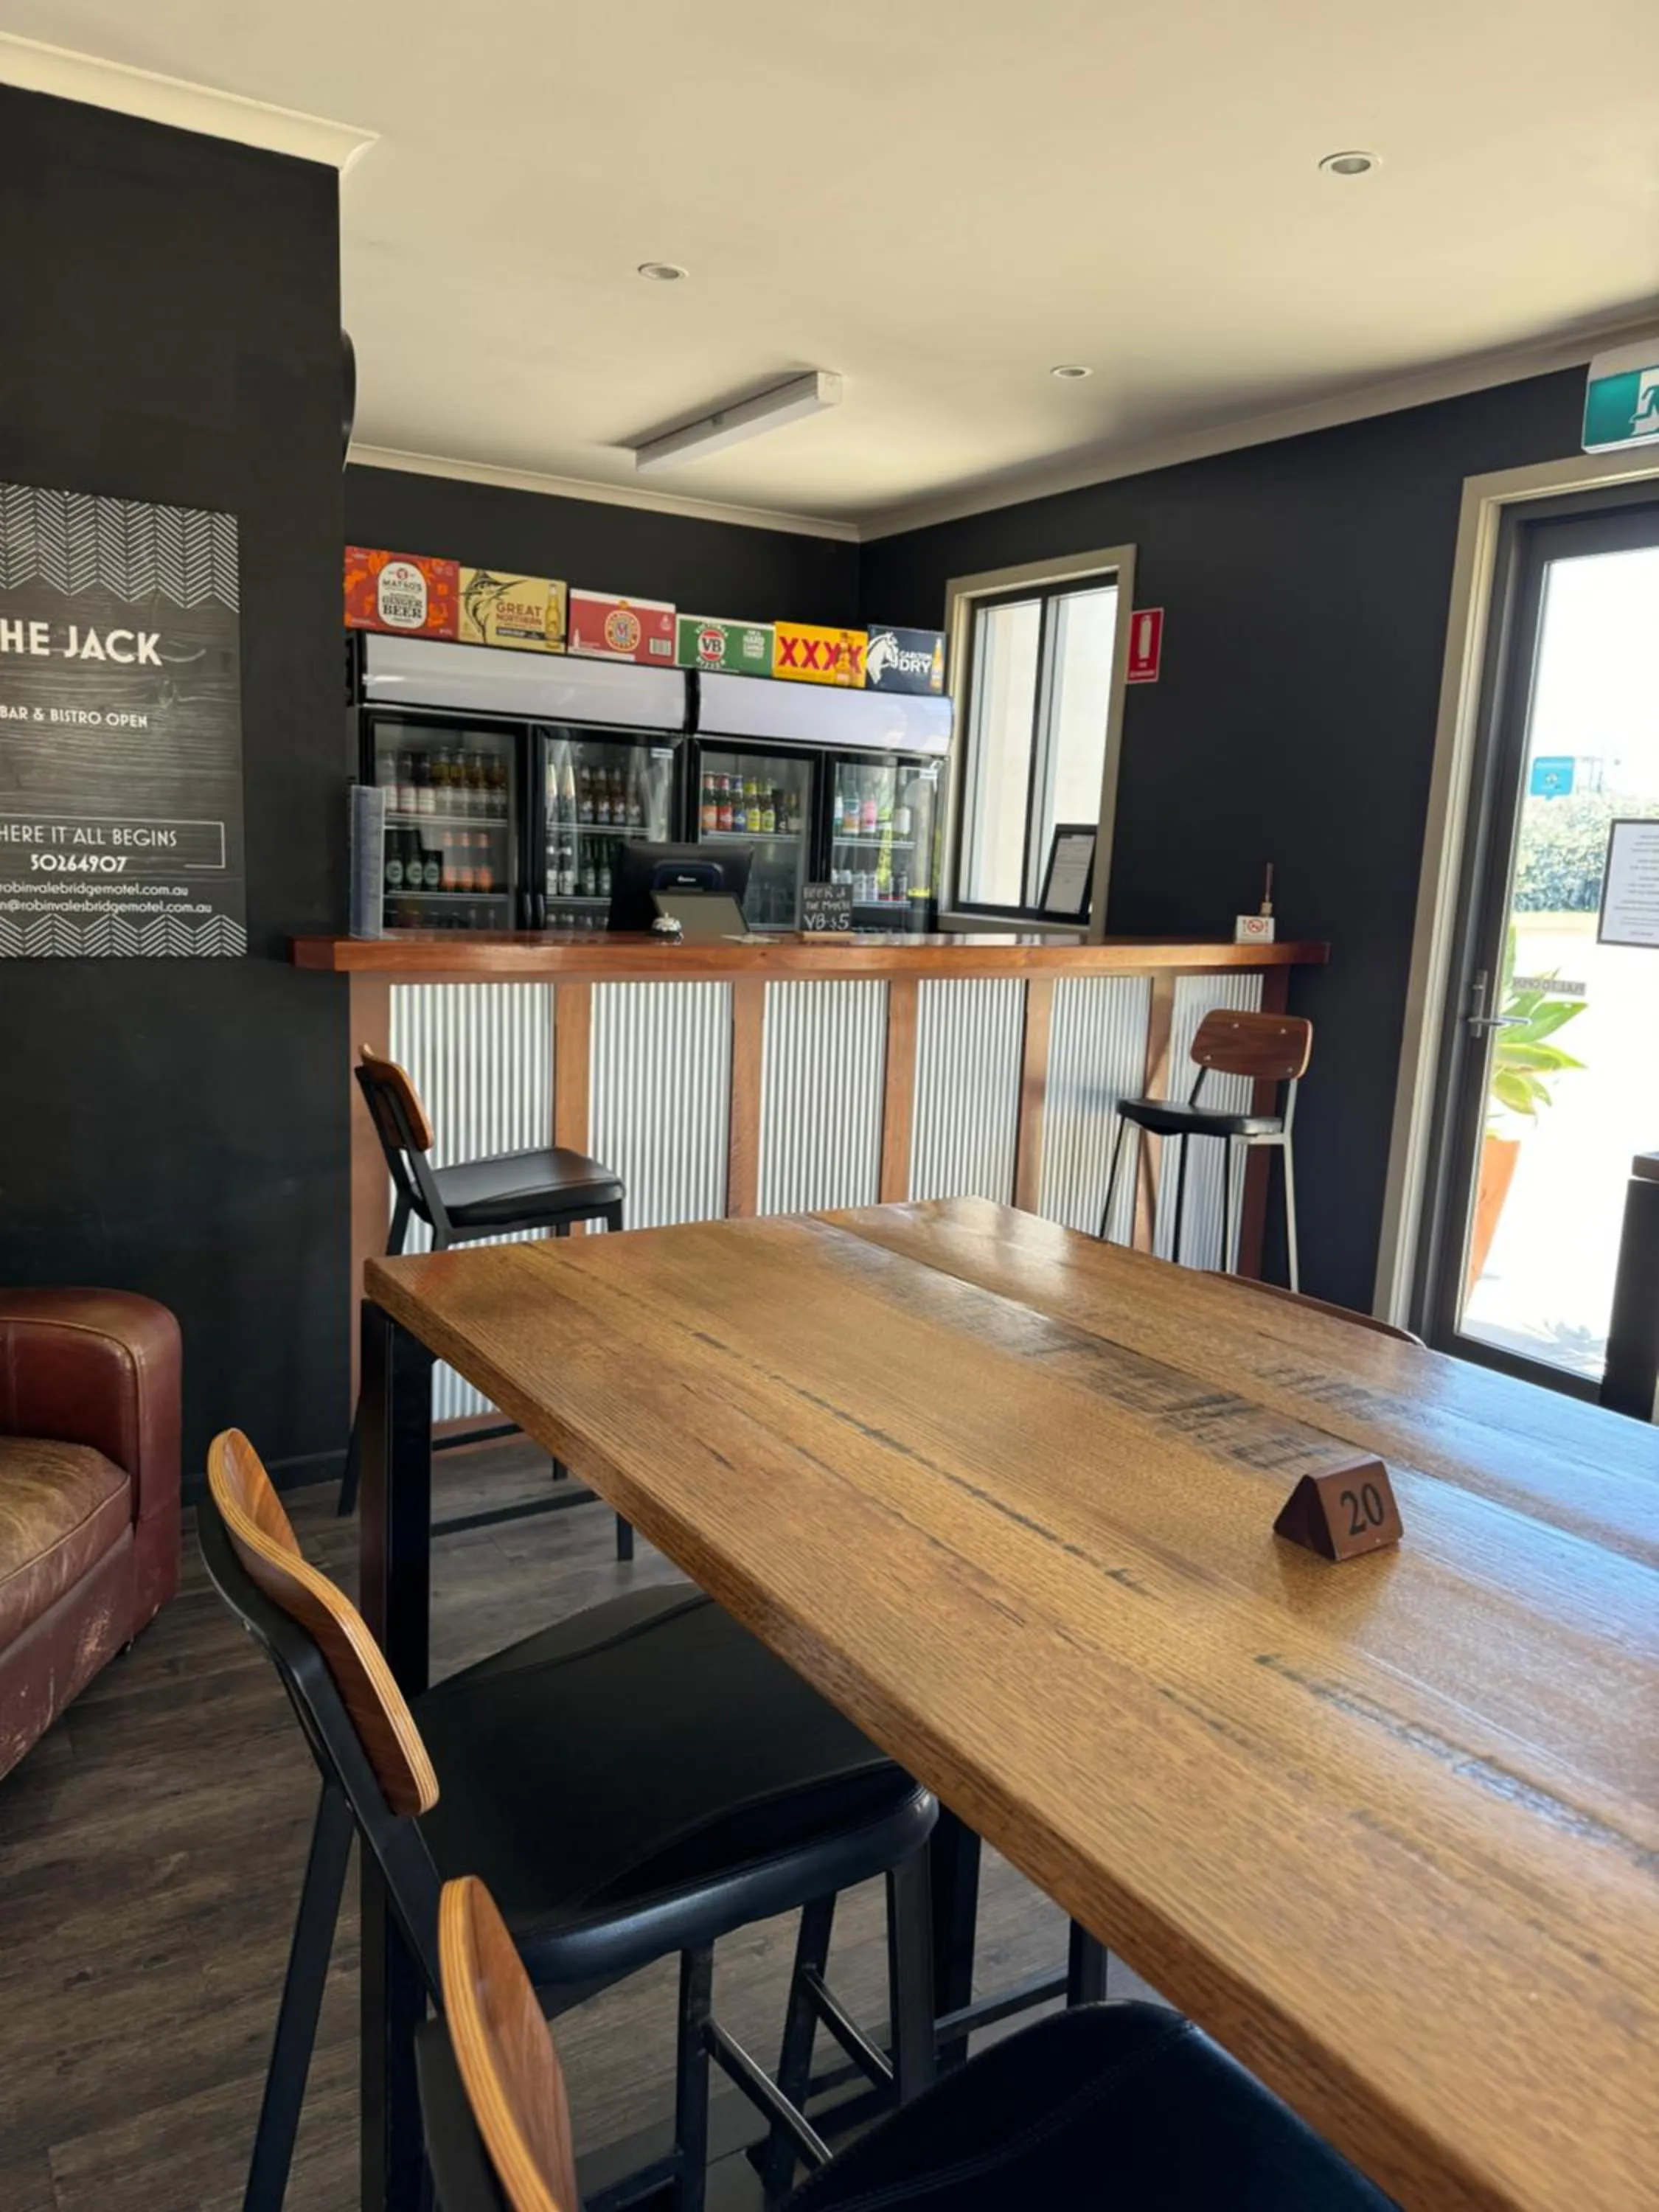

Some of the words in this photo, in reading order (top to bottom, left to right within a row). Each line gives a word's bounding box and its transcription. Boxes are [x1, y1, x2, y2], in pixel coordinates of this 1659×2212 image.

[383, 604, 422, 619] BEER
[496, 601, 543, 616] GREAT
[495, 613, 542, 626] NORTHERN
[63, 625, 162, 666] JACK
[701, 638, 722, 652] VB
[899, 658, 932, 673] DRY
[0, 705, 28, 720] BAR
[33, 708, 44, 721] &
[50, 709, 102, 726] BISTRO
[105, 713, 147, 728] OPEN
[52, 825, 67, 844] IT
[73, 827, 106, 846] ALL
[112, 828, 177, 847] BEGINS
[30, 853, 128, 873] 50264907
[1340, 1483, 1384, 1536] 20
